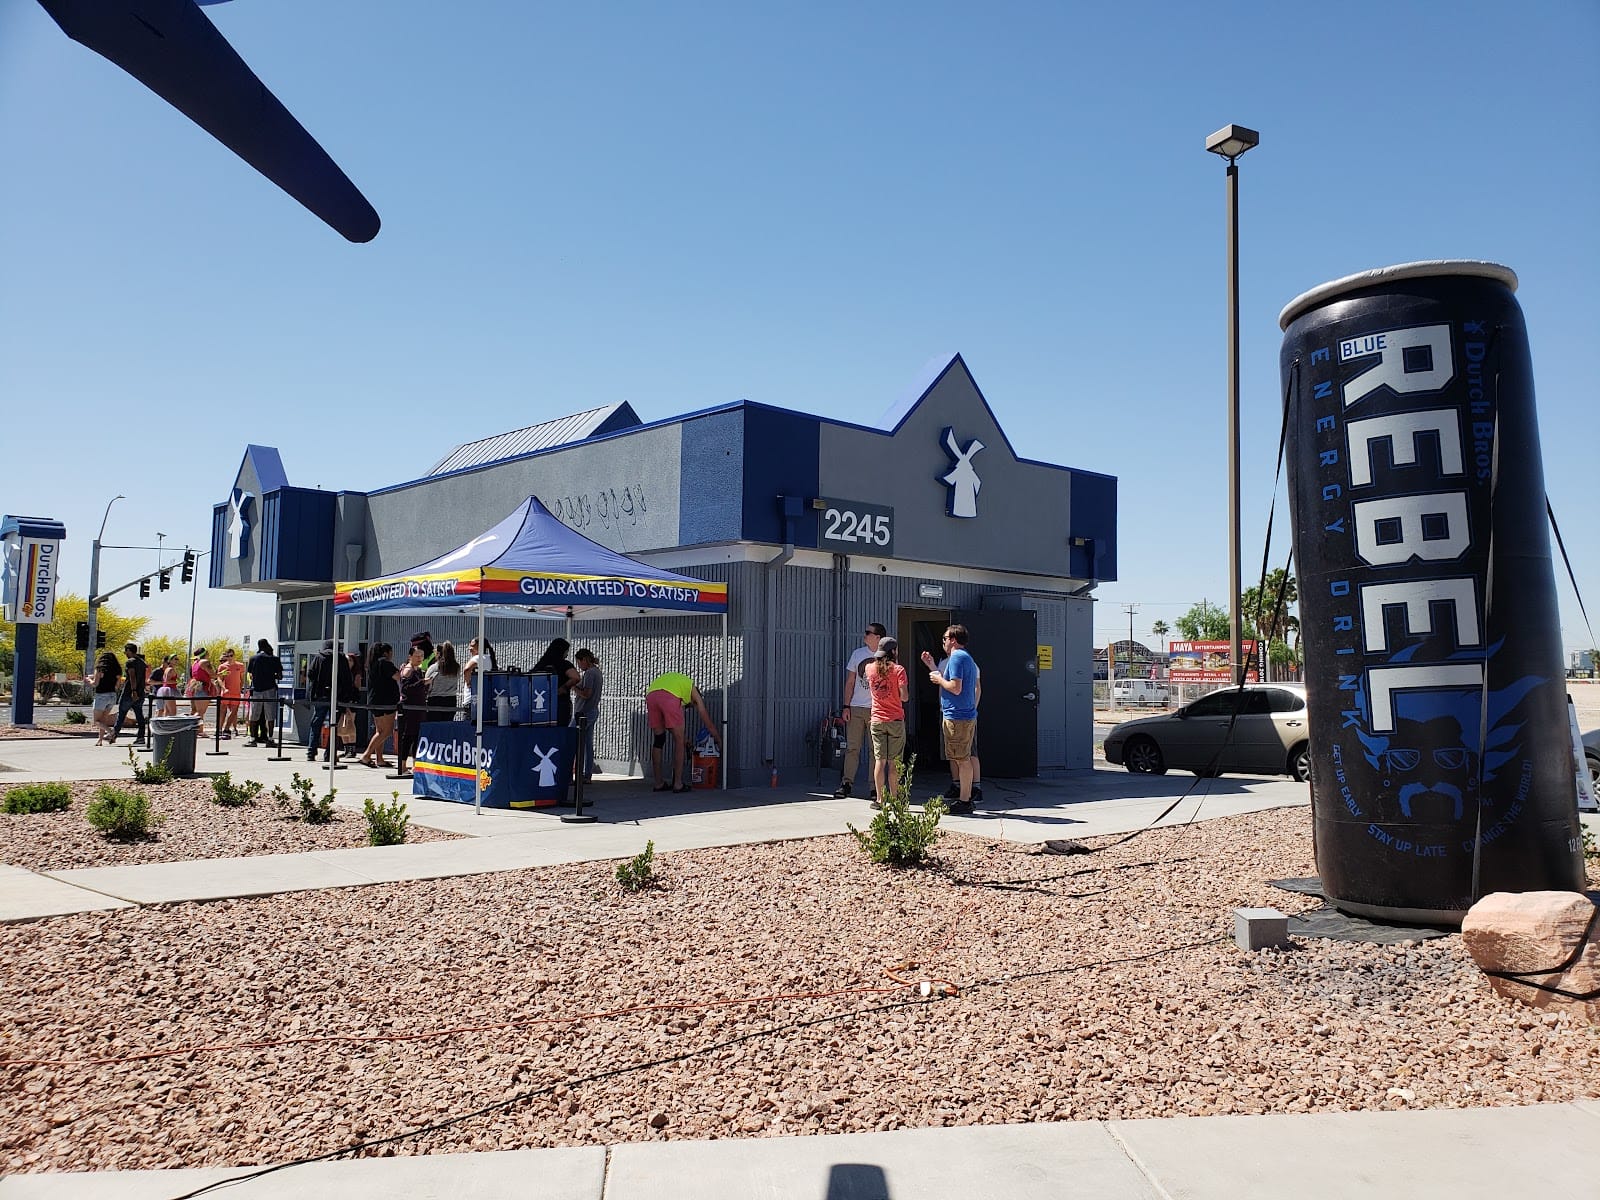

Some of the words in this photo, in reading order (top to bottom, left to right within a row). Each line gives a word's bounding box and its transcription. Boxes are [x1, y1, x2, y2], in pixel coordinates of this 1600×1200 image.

[1342, 334, 1388, 358] BLUE
[824, 508, 891, 546] 2245
[1310, 346, 1345, 535] ENERGY
[1329, 580, 1362, 730] DRINK
[1339, 323, 1484, 732] REBEL
[350, 582, 406, 604] GUARANTEED
[406, 580, 420, 598] TO
[421, 578, 459, 597] SATISFY
[519, 577, 625, 597] GUARANTEED
[626, 581, 648, 598] TO
[649, 583, 700, 603] SATISFY
[1173, 642, 1193, 652] MAYA
[1333, 743, 1344, 766] GET
[1336, 768, 1346, 784] UP
[1341, 786, 1363, 817] EARLY
[1367, 823, 1394, 846] STAY
[1395, 839, 1412, 853] UP
[1415, 844, 1448, 857] LATE
